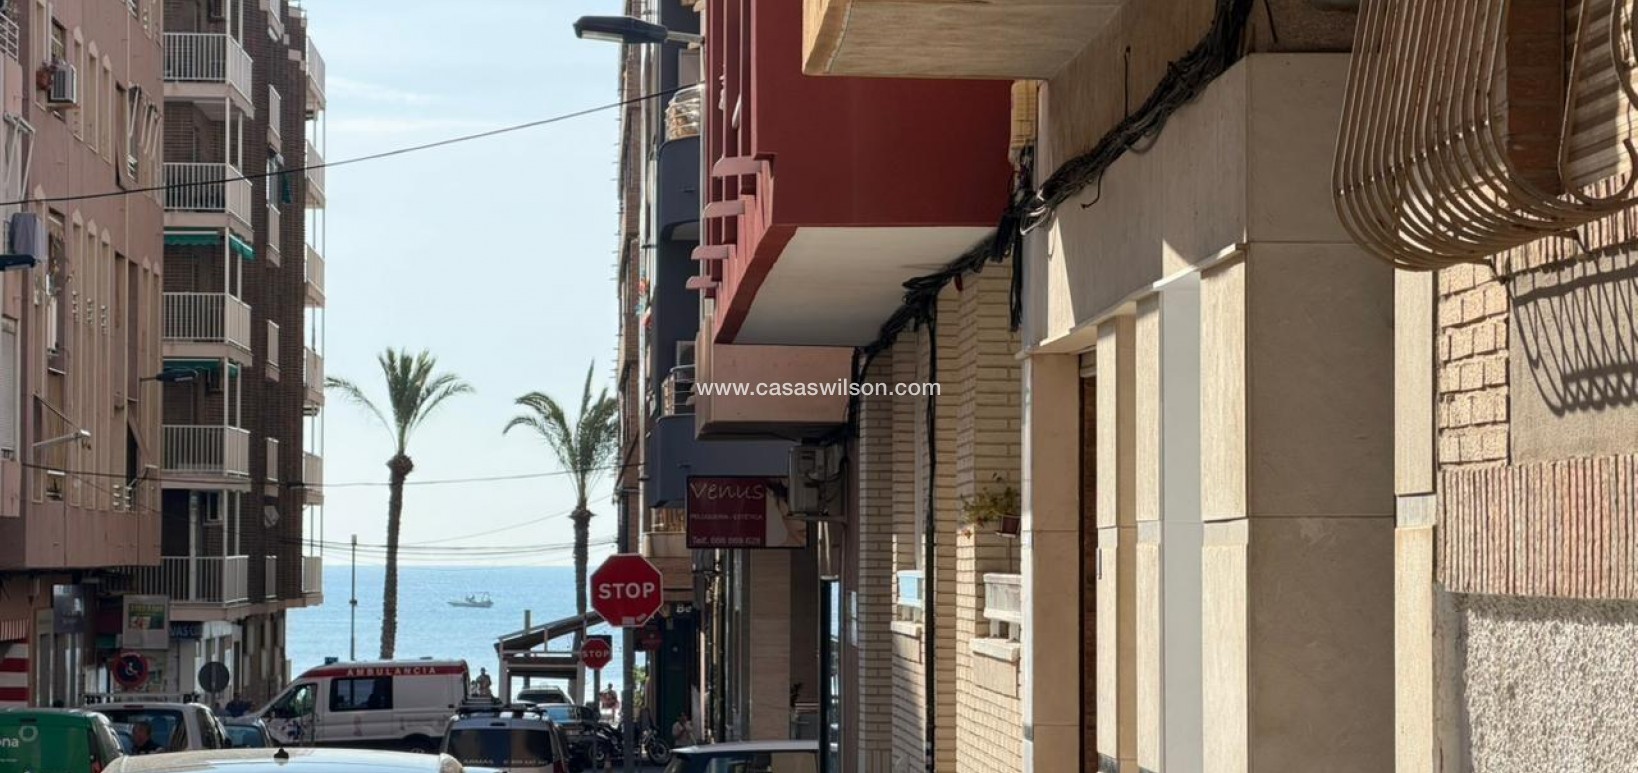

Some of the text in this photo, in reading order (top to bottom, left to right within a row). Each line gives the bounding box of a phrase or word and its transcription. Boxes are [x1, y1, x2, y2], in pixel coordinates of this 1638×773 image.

[690, 481, 765, 500] Venus
[598, 582, 655, 600] STOP
[582, 650, 609, 658] STOP
[347, 666, 437, 677] AMBULANCIA
